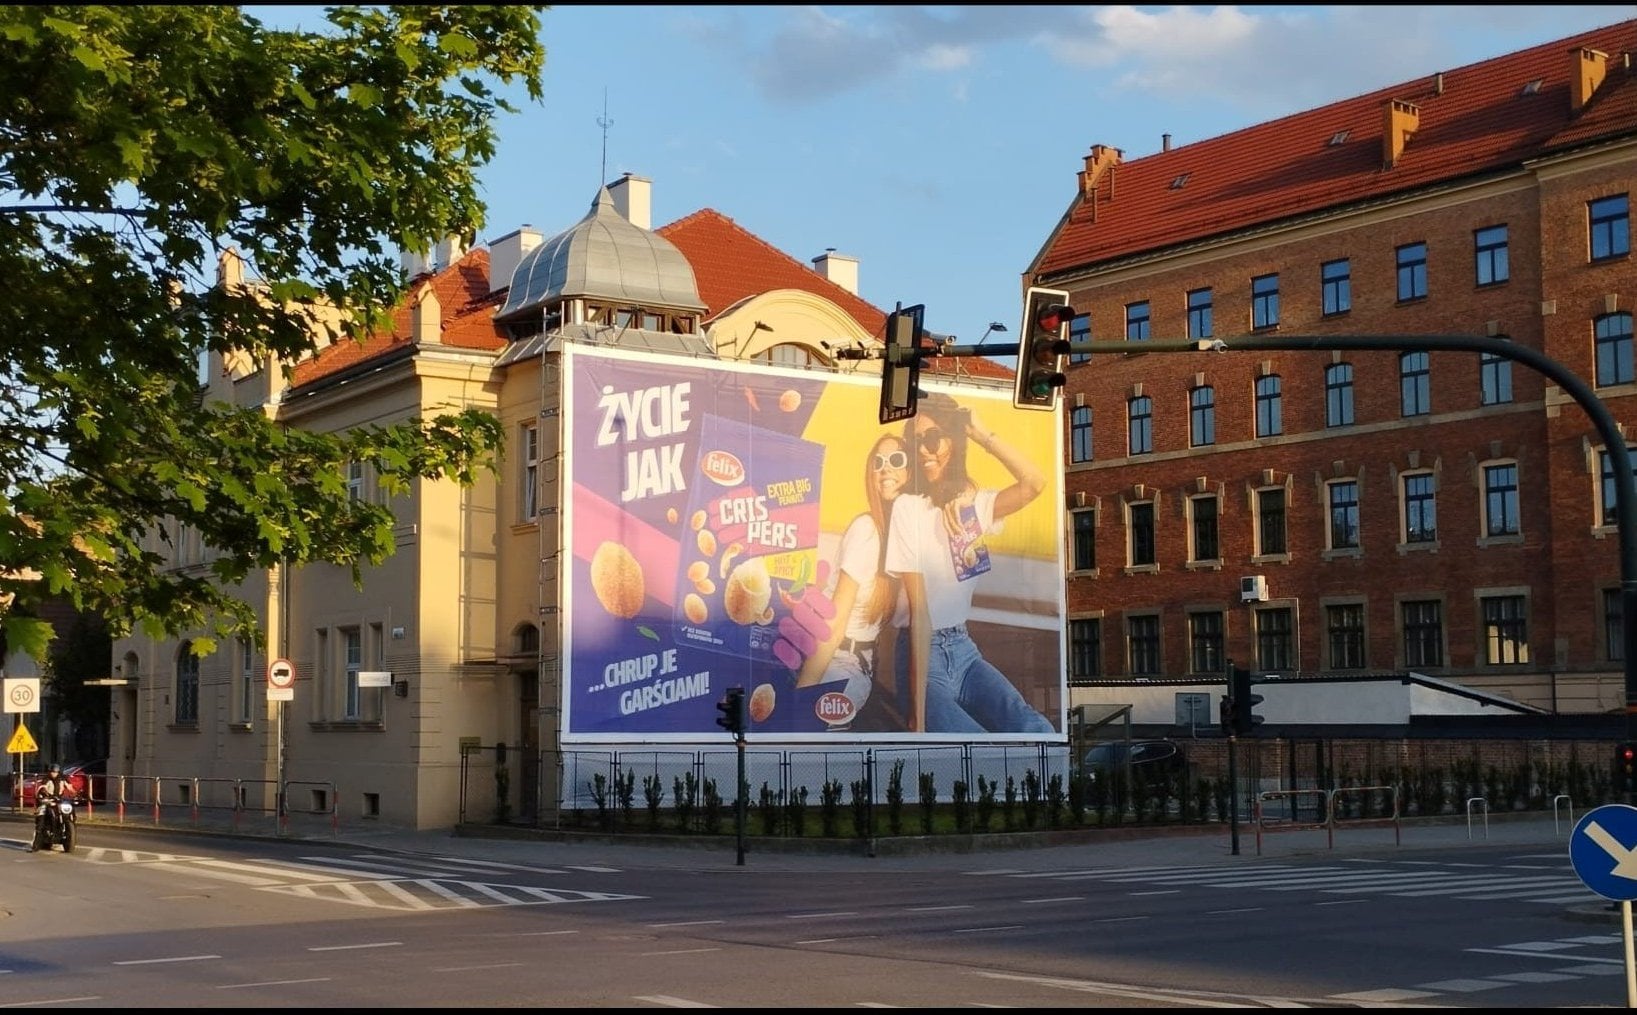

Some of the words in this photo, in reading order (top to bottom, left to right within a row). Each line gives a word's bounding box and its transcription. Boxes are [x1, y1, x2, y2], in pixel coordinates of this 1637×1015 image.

[597, 381, 691, 447] ŻYCIE
[621, 442, 686, 502] JAK
[706, 453, 740, 478] felix
[767, 481, 796, 499] EXTRA
[795, 478, 811, 493] BIG
[719, 496, 768, 525] CRIS
[747, 520, 797, 549] PERS
[659, 648, 678, 675] JE
[14, 690, 30, 701] 30
[620, 671, 710, 715] GARŚCIAMI!
[820, 696, 850, 715] felix
